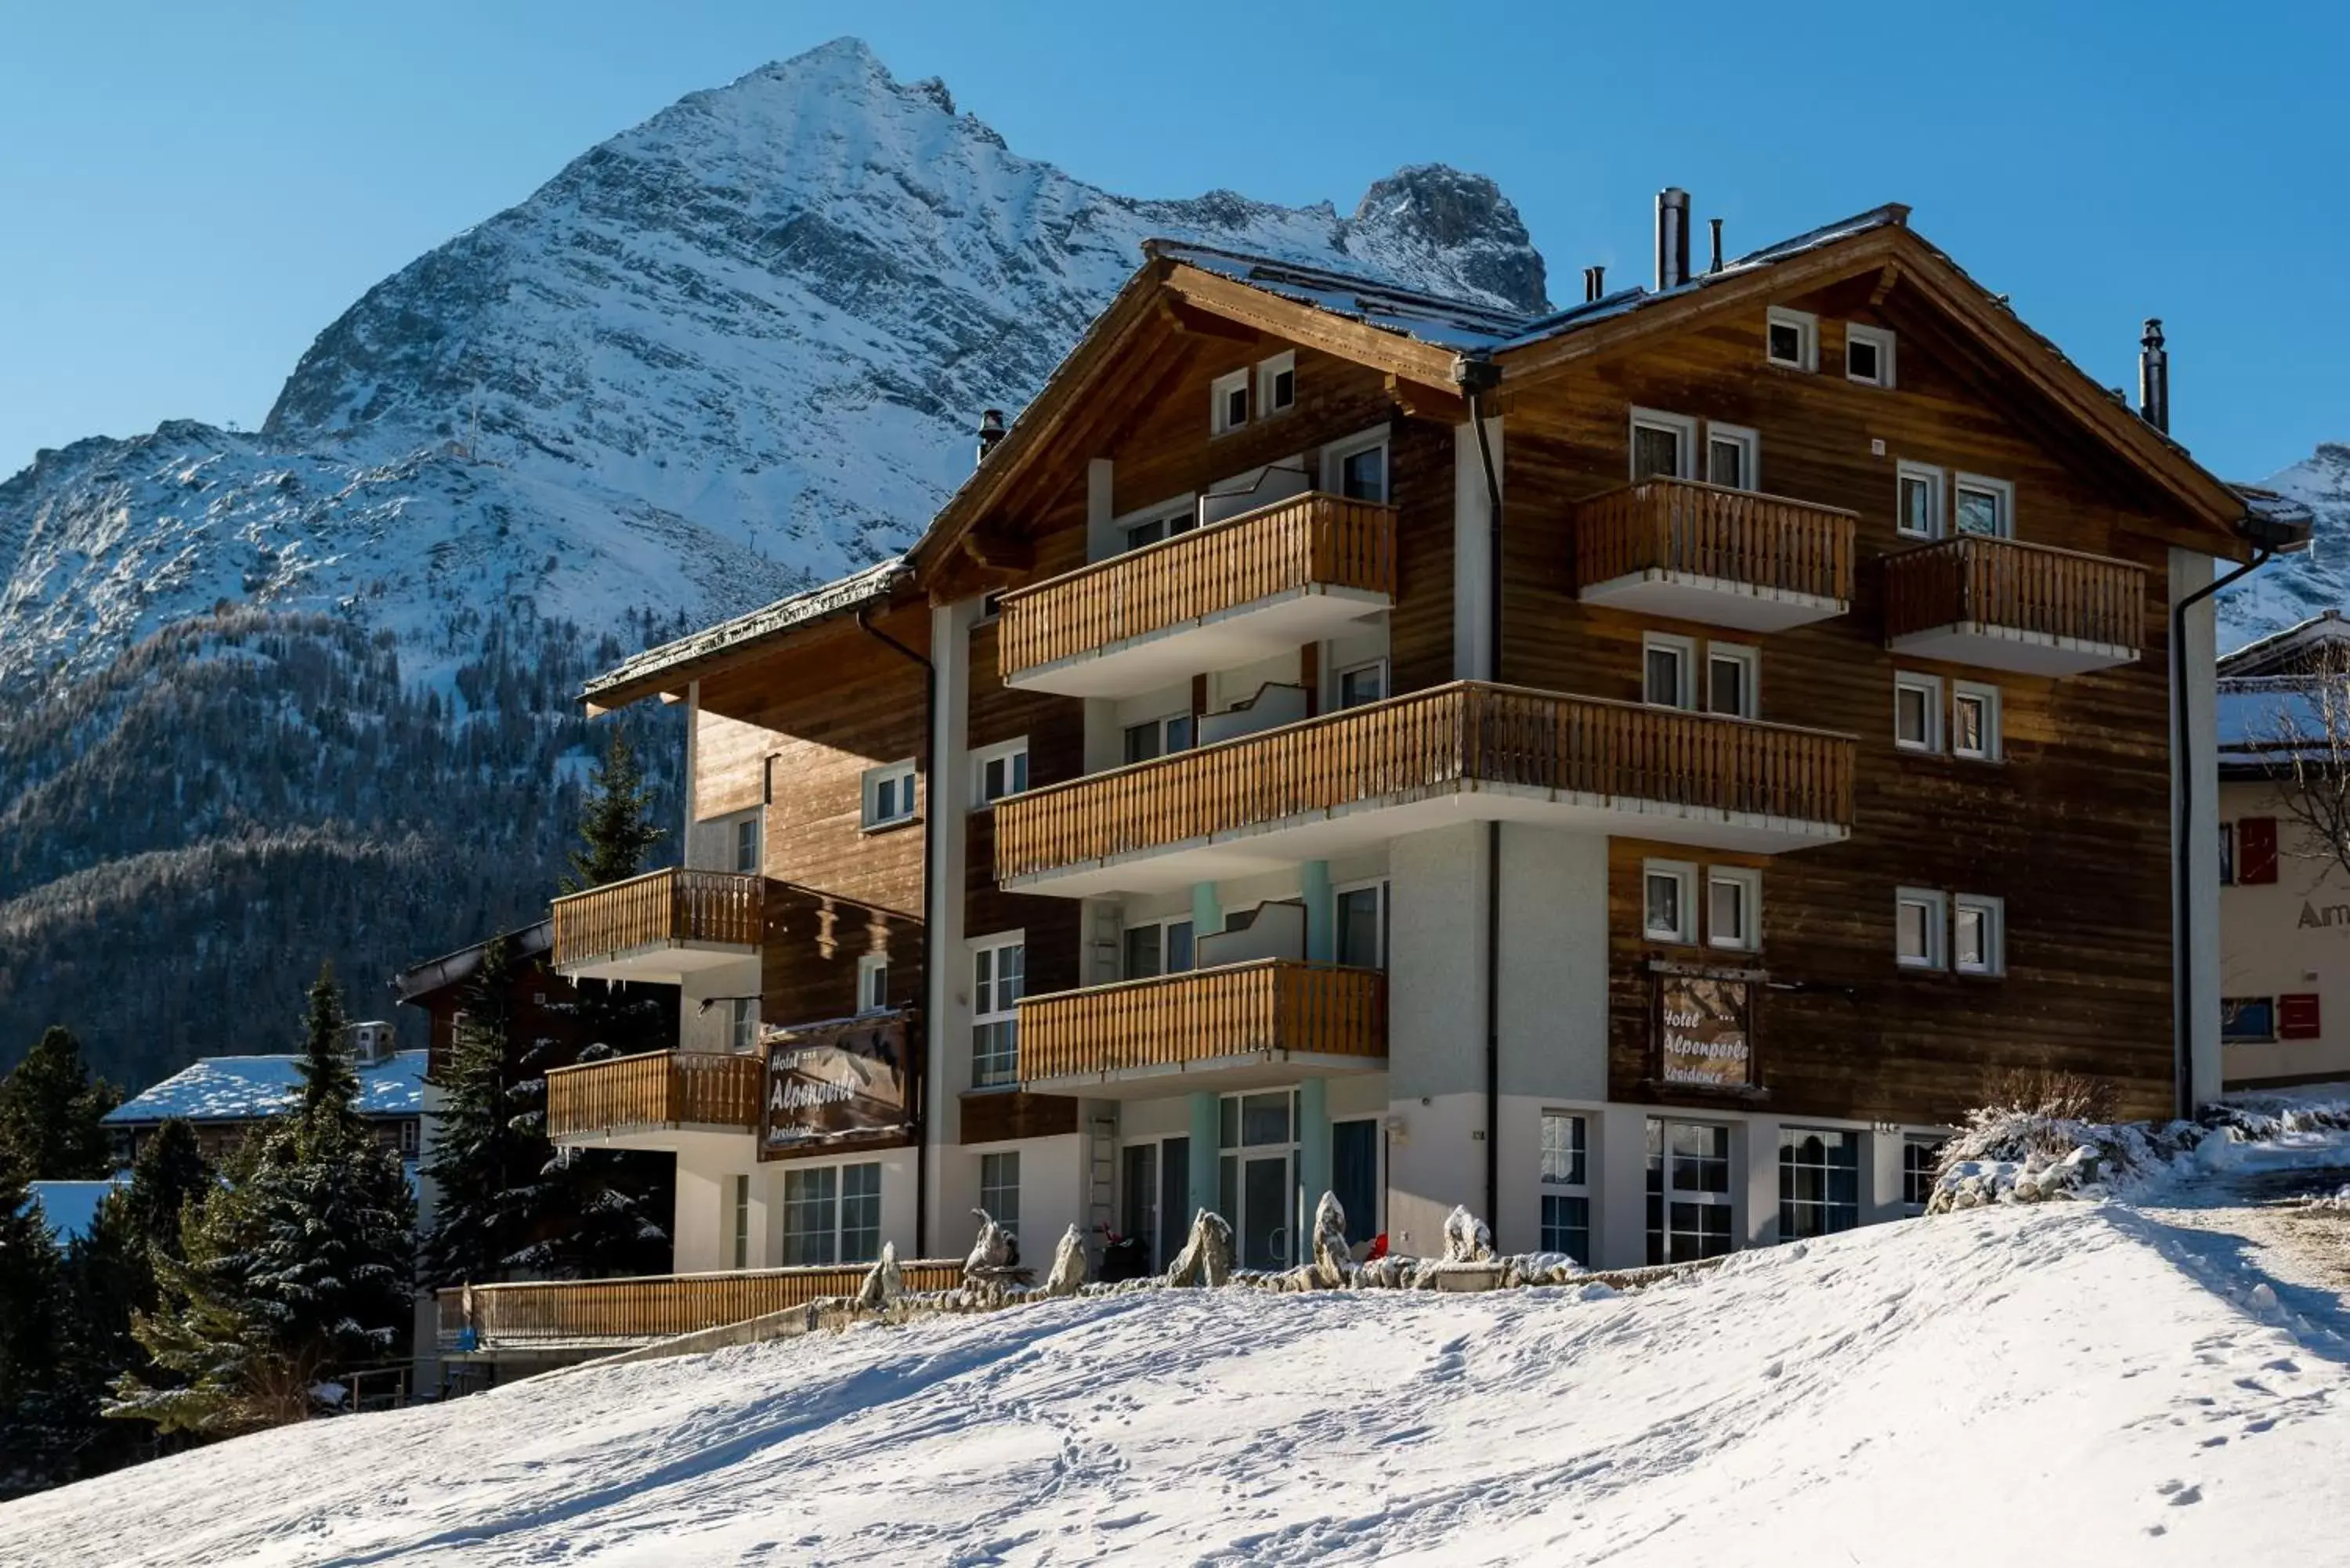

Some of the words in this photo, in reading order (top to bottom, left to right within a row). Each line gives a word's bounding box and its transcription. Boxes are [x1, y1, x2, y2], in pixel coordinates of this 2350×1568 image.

[1664, 1009, 1699, 1028] Hotel
[1665, 1031, 1748, 1060] Alpenperle
[772, 1051, 798, 1072] Hotel
[770, 1069, 855, 1115] Alpenperle
